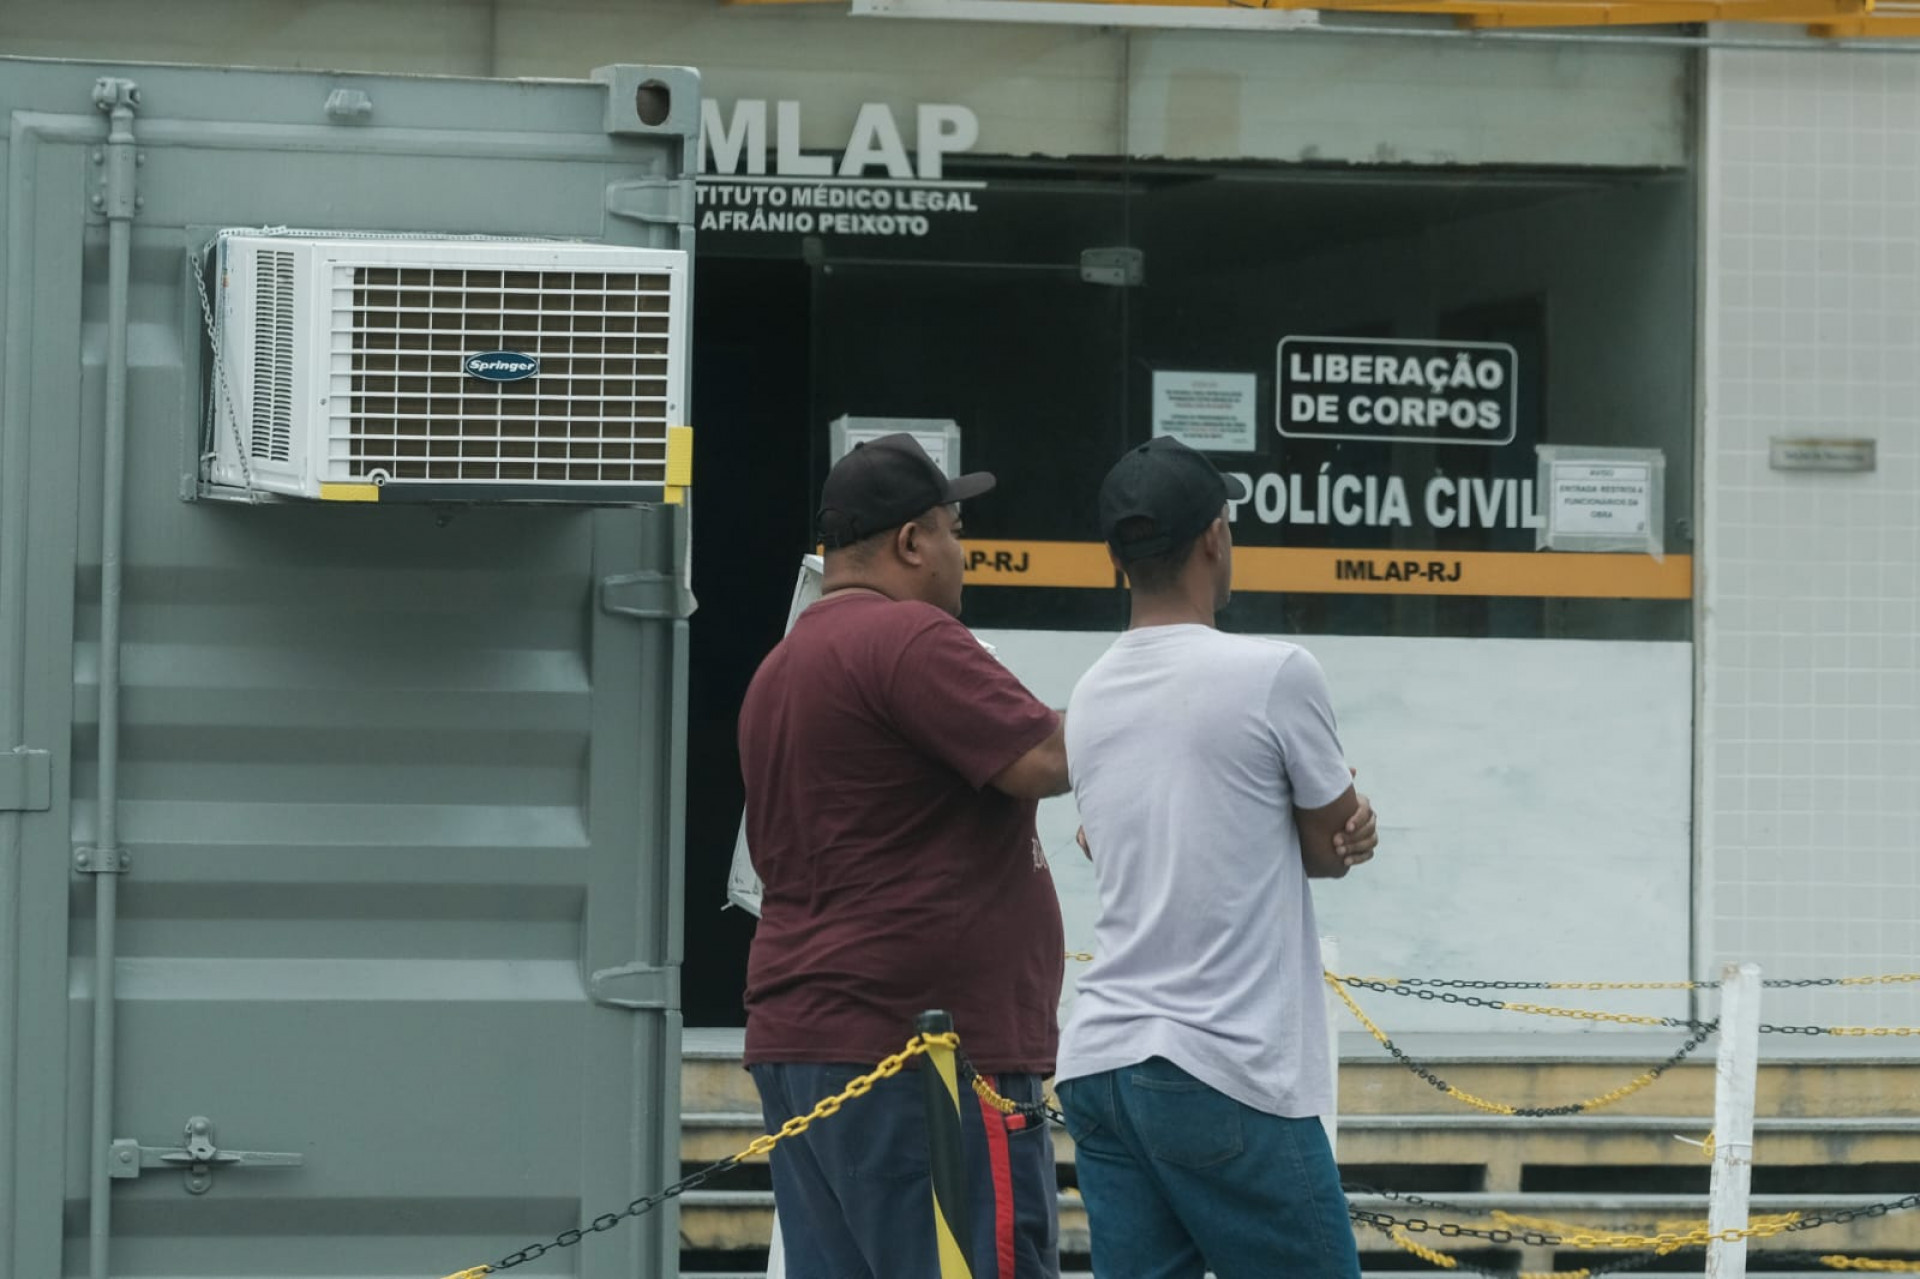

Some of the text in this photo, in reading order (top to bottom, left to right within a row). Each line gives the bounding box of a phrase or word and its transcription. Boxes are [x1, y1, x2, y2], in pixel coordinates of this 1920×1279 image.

[791, 183, 892, 210] MÉDICO
[895, 190, 978, 212] LEGAL
[701, 209, 929, 236] AFRÂNIO PEIXOTO
[468, 359, 535, 373] Springer
[1290, 352, 1504, 394] LIBERAÇÃO
[1291, 394, 1501, 430] DE CORPOS
[1425, 477, 1547, 529] CIVIL
[1336, 559, 1461, 582] IMLAP-RJ
